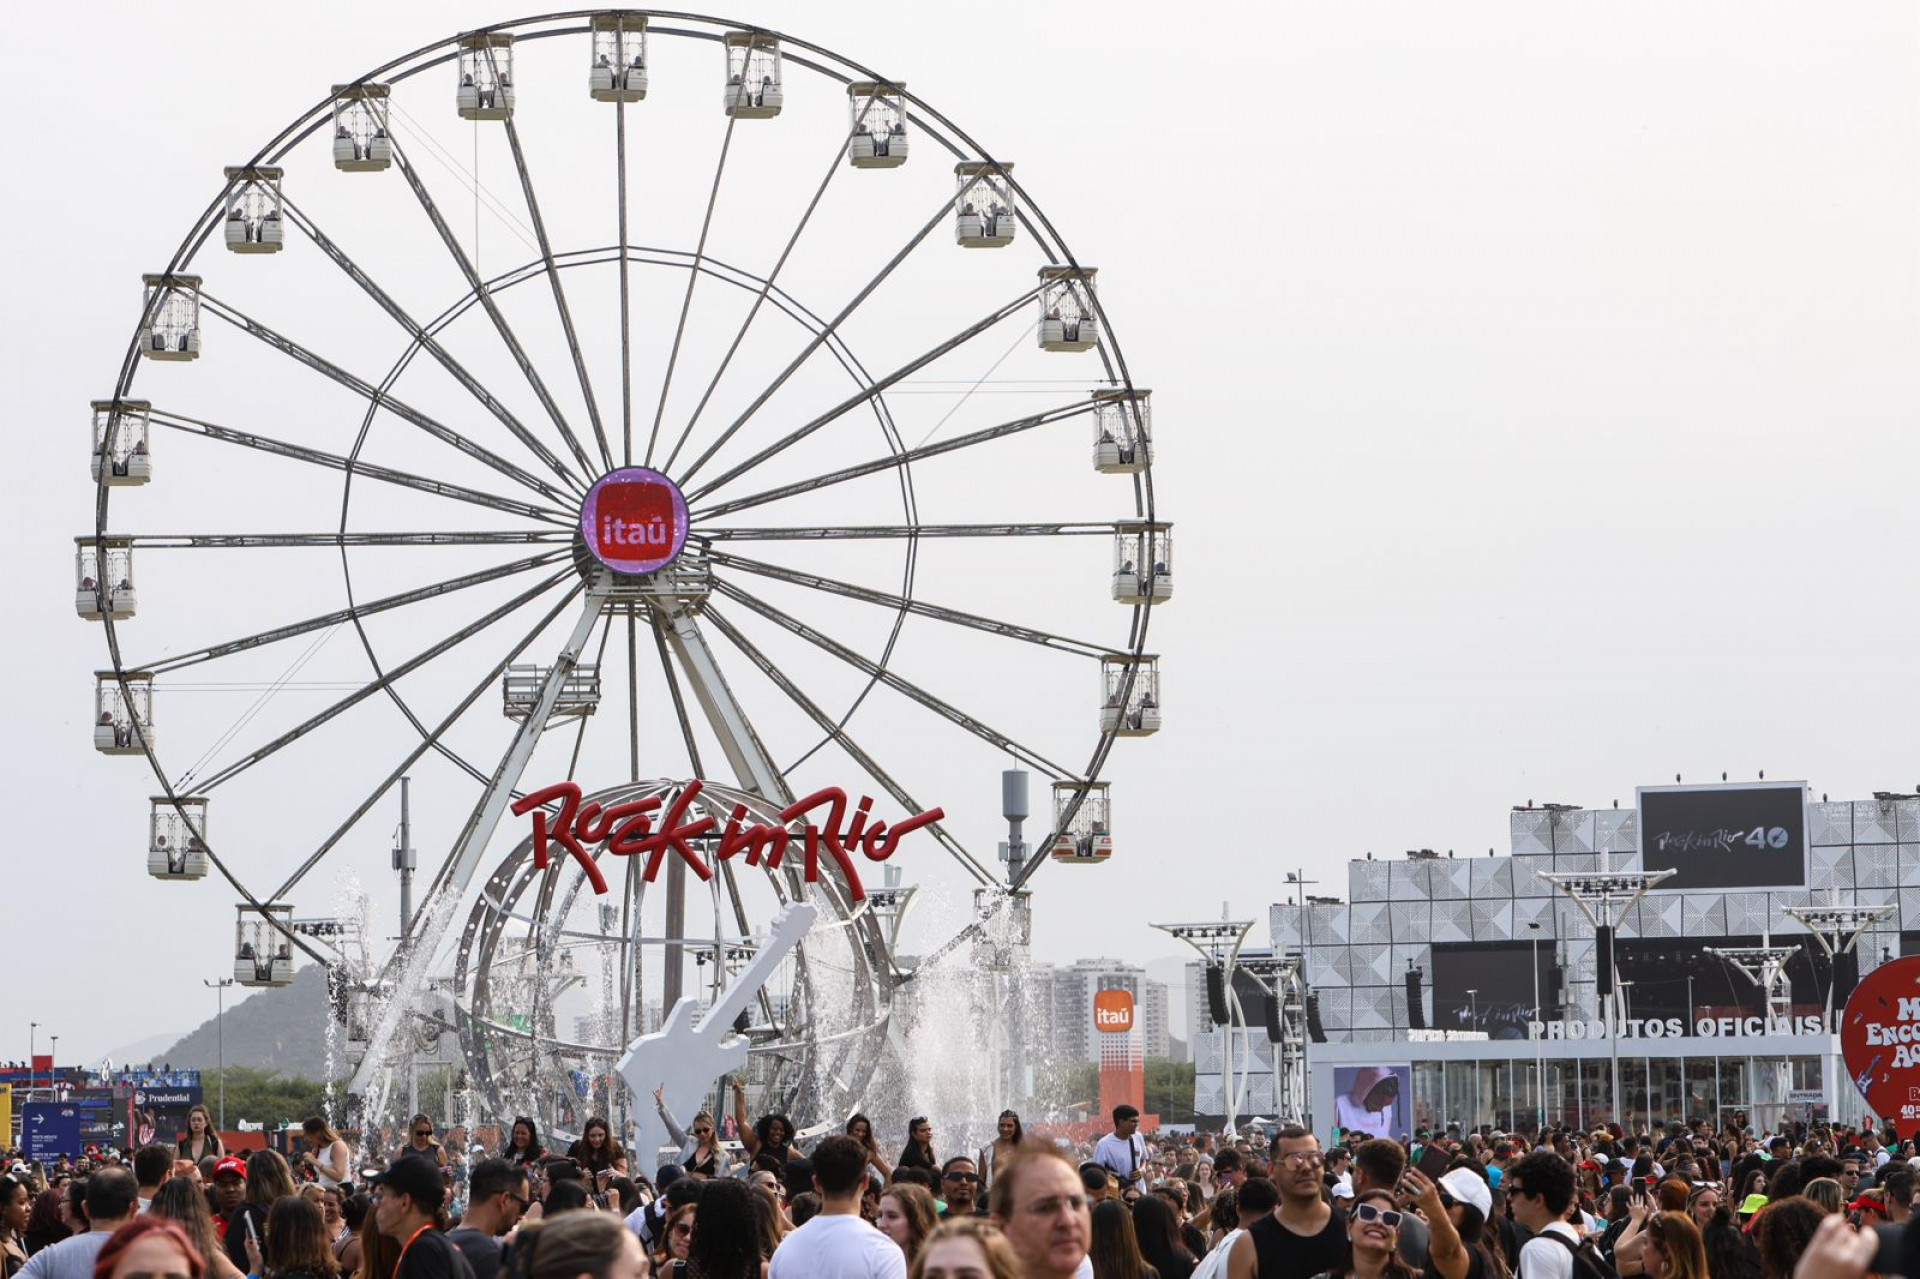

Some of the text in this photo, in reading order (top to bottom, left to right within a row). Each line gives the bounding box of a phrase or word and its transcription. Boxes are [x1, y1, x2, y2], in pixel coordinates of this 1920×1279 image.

[603, 515, 666, 545] itaú
[511, 778, 945, 902] Rock in Rio
[1097, 1008, 1129, 1024] itaú
[1528, 1016, 1823, 1040] PRODUTOS OFICIAIS
[149, 1093, 190, 1103] Prudential
